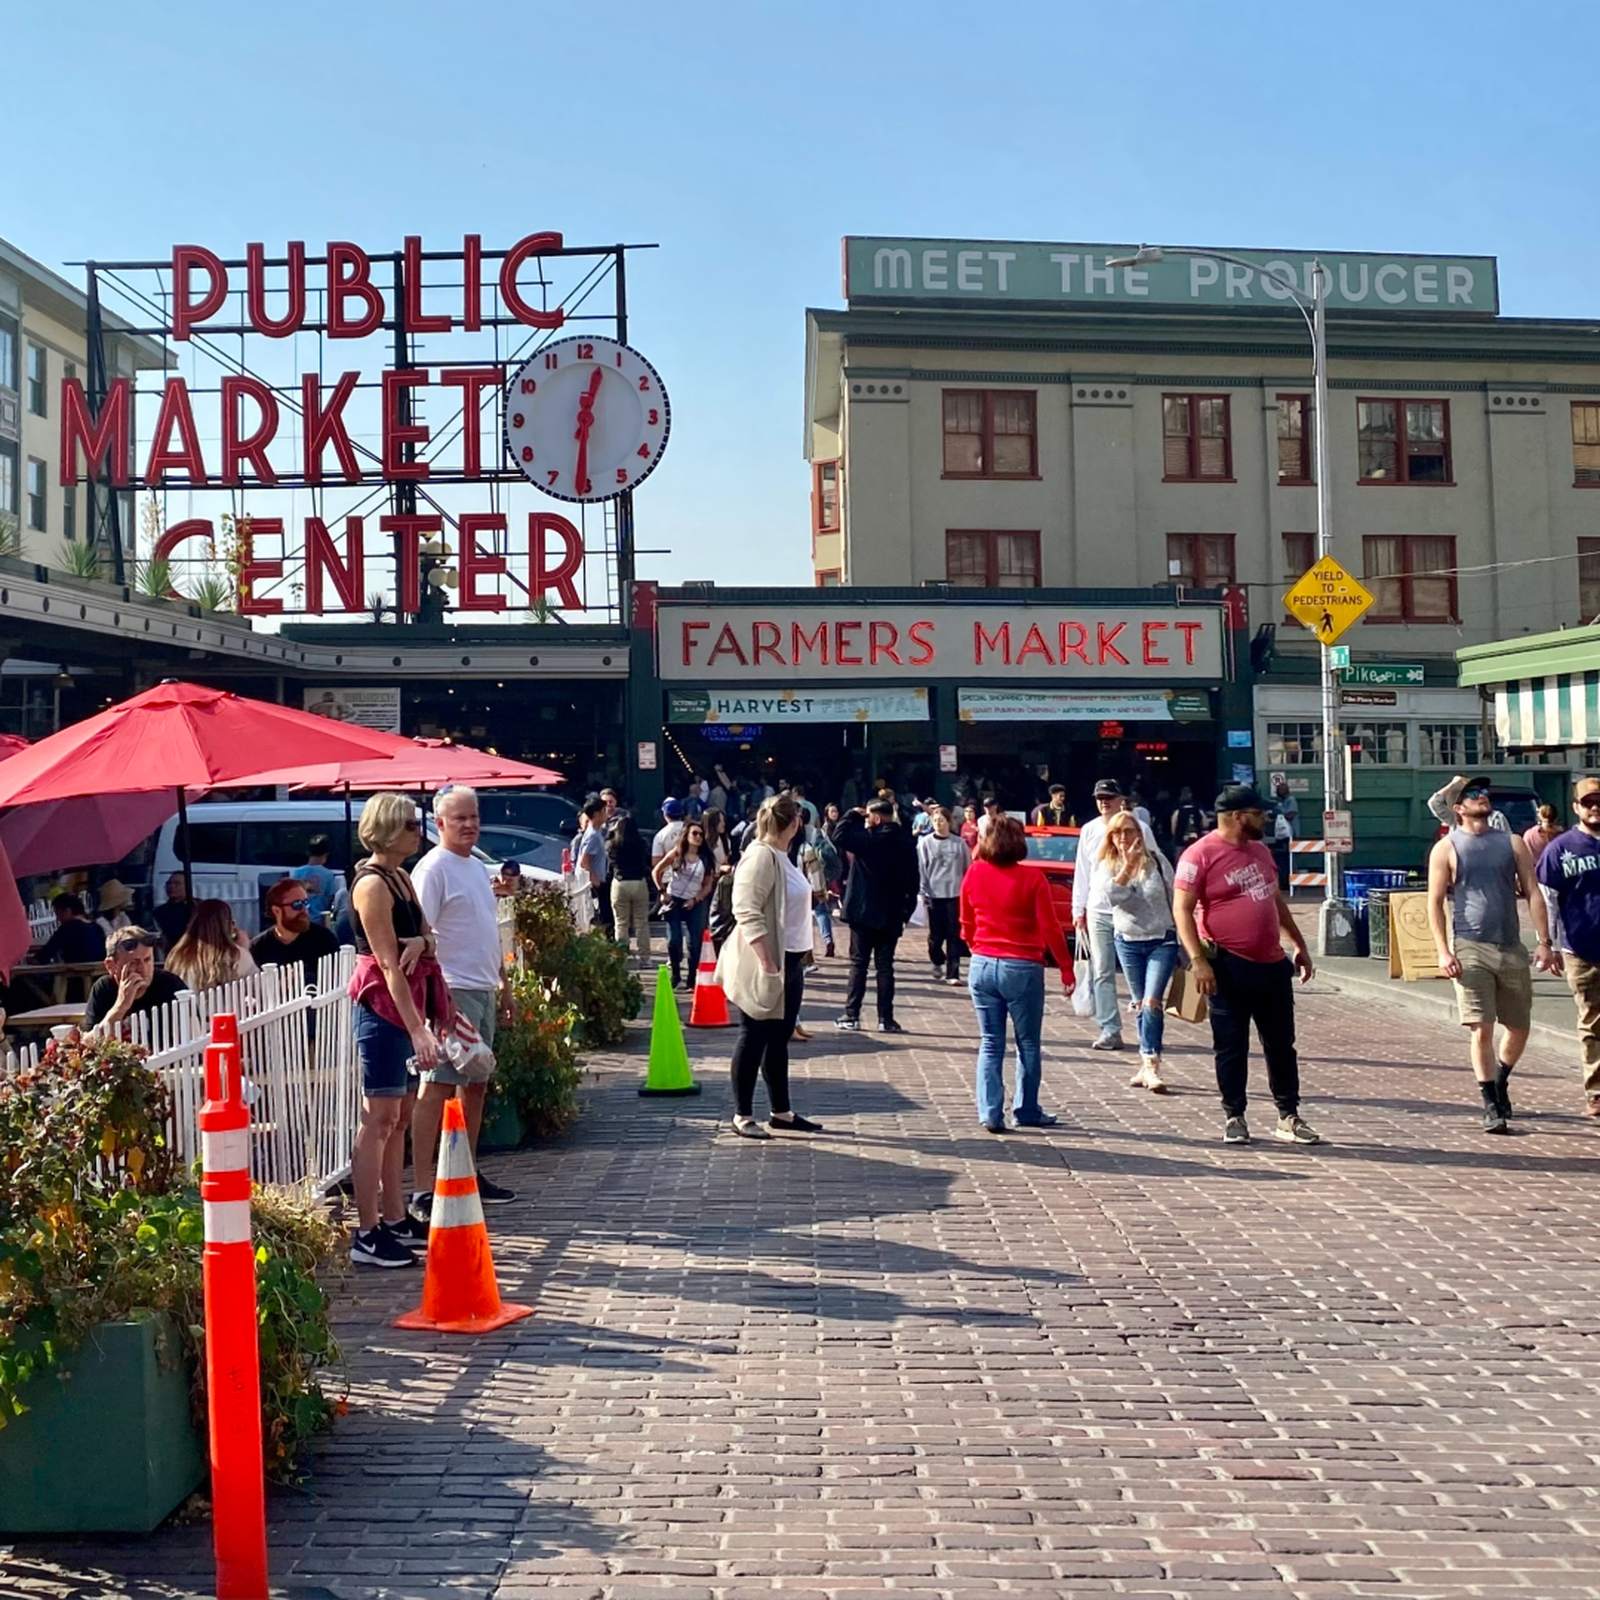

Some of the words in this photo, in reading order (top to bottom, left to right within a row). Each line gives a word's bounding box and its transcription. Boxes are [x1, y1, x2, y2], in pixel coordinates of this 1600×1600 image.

[874, 247, 1017, 291] MEET
[1050, 252, 1149, 296] THE
[1189, 257, 1475, 305] PRODUCER
[172, 231, 564, 341] PUBLIC
[577, 343, 594, 359] 12
[545, 353, 558, 369] 11
[616, 352, 622, 367] 1
[521, 379, 536, 394] 10
[638, 376, 650, 391] 2
[513, 413, 525, 428] 9
[648, 409, 658, 425] 3
[60, 367, 503, 487] MARKET
[521, 446, 534, 462] 8
[637, 443, 650, 459] 4
[547, 470, 559, 485] 7
[616, 469, 628, 483] 5
[154, 511, 586, 615] CENTER
[1313, 571, 1344, 581] YIELD
[1321, 583, 1335, 593] TO
[1293, 595, 1363, 606] PEDESTRIANS
[681, 621, 936, 666] FARMERS
[973, 621, 1204, 666] MARKET
[1346, 667, 1378, 682] Pike
[717, 699, 815, 714] HARVEST
[821, 697, 922, 714] FESTIVAL
[1560, 855, 1600, 878] MAR
